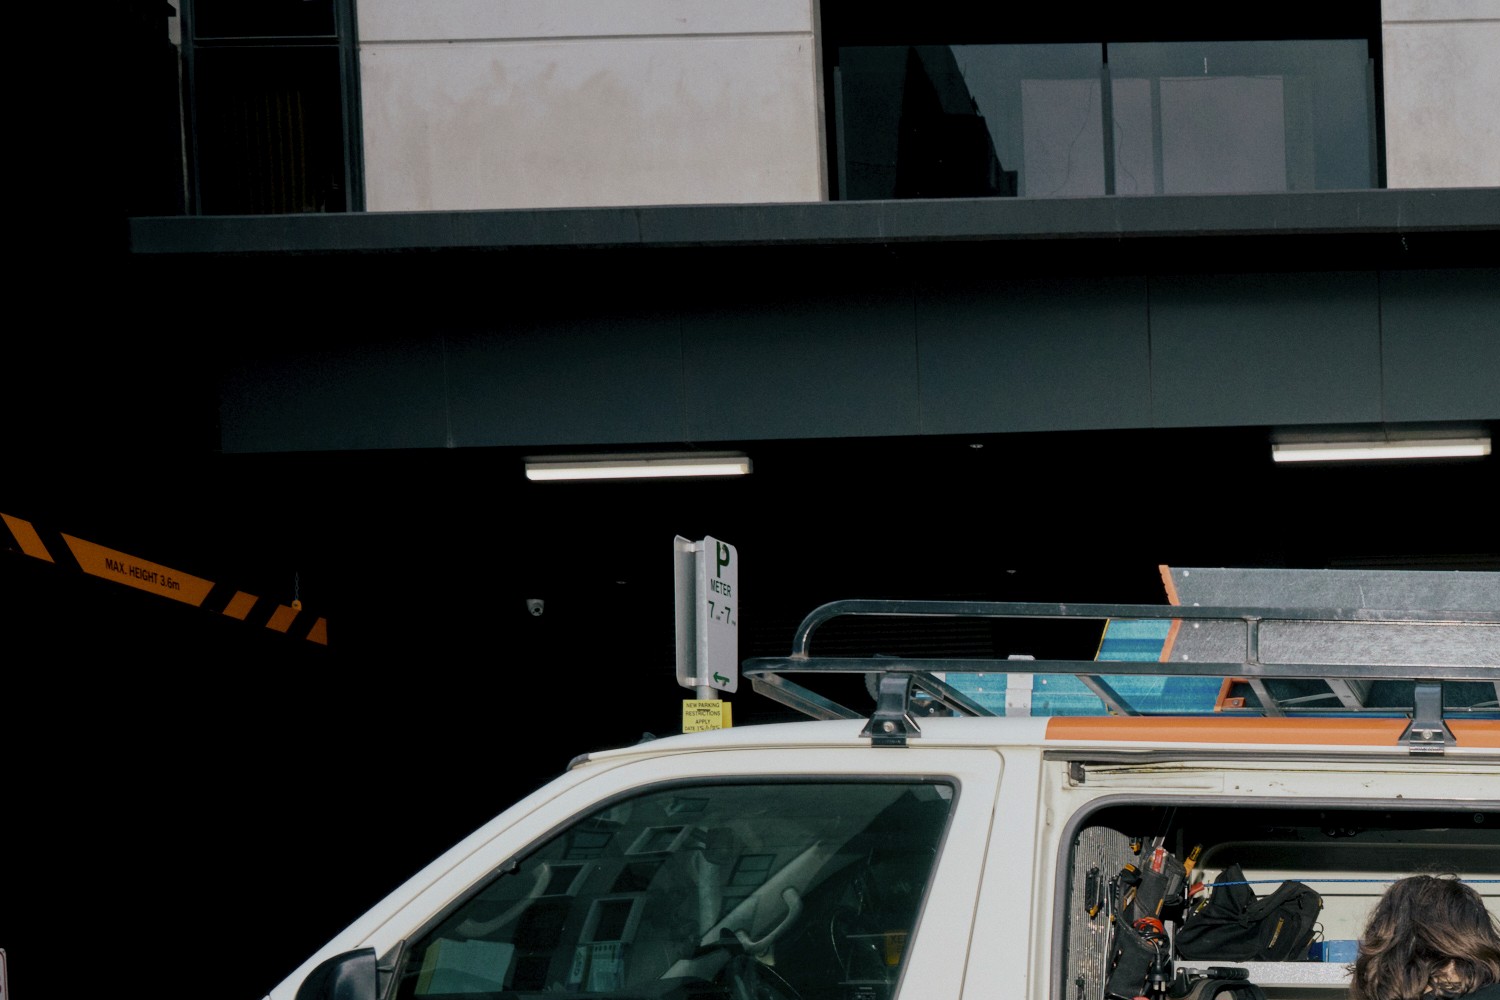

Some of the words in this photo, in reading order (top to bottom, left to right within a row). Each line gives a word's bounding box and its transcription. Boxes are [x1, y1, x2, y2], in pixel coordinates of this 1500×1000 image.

[105, 558, 127, 575] MAX.
[129, 565, 158, 584] HEIGHT
[160, 575, 180, 590] 3.6m
[716, 541, 730, 578] P
[710, 578, 732, 598] METER
